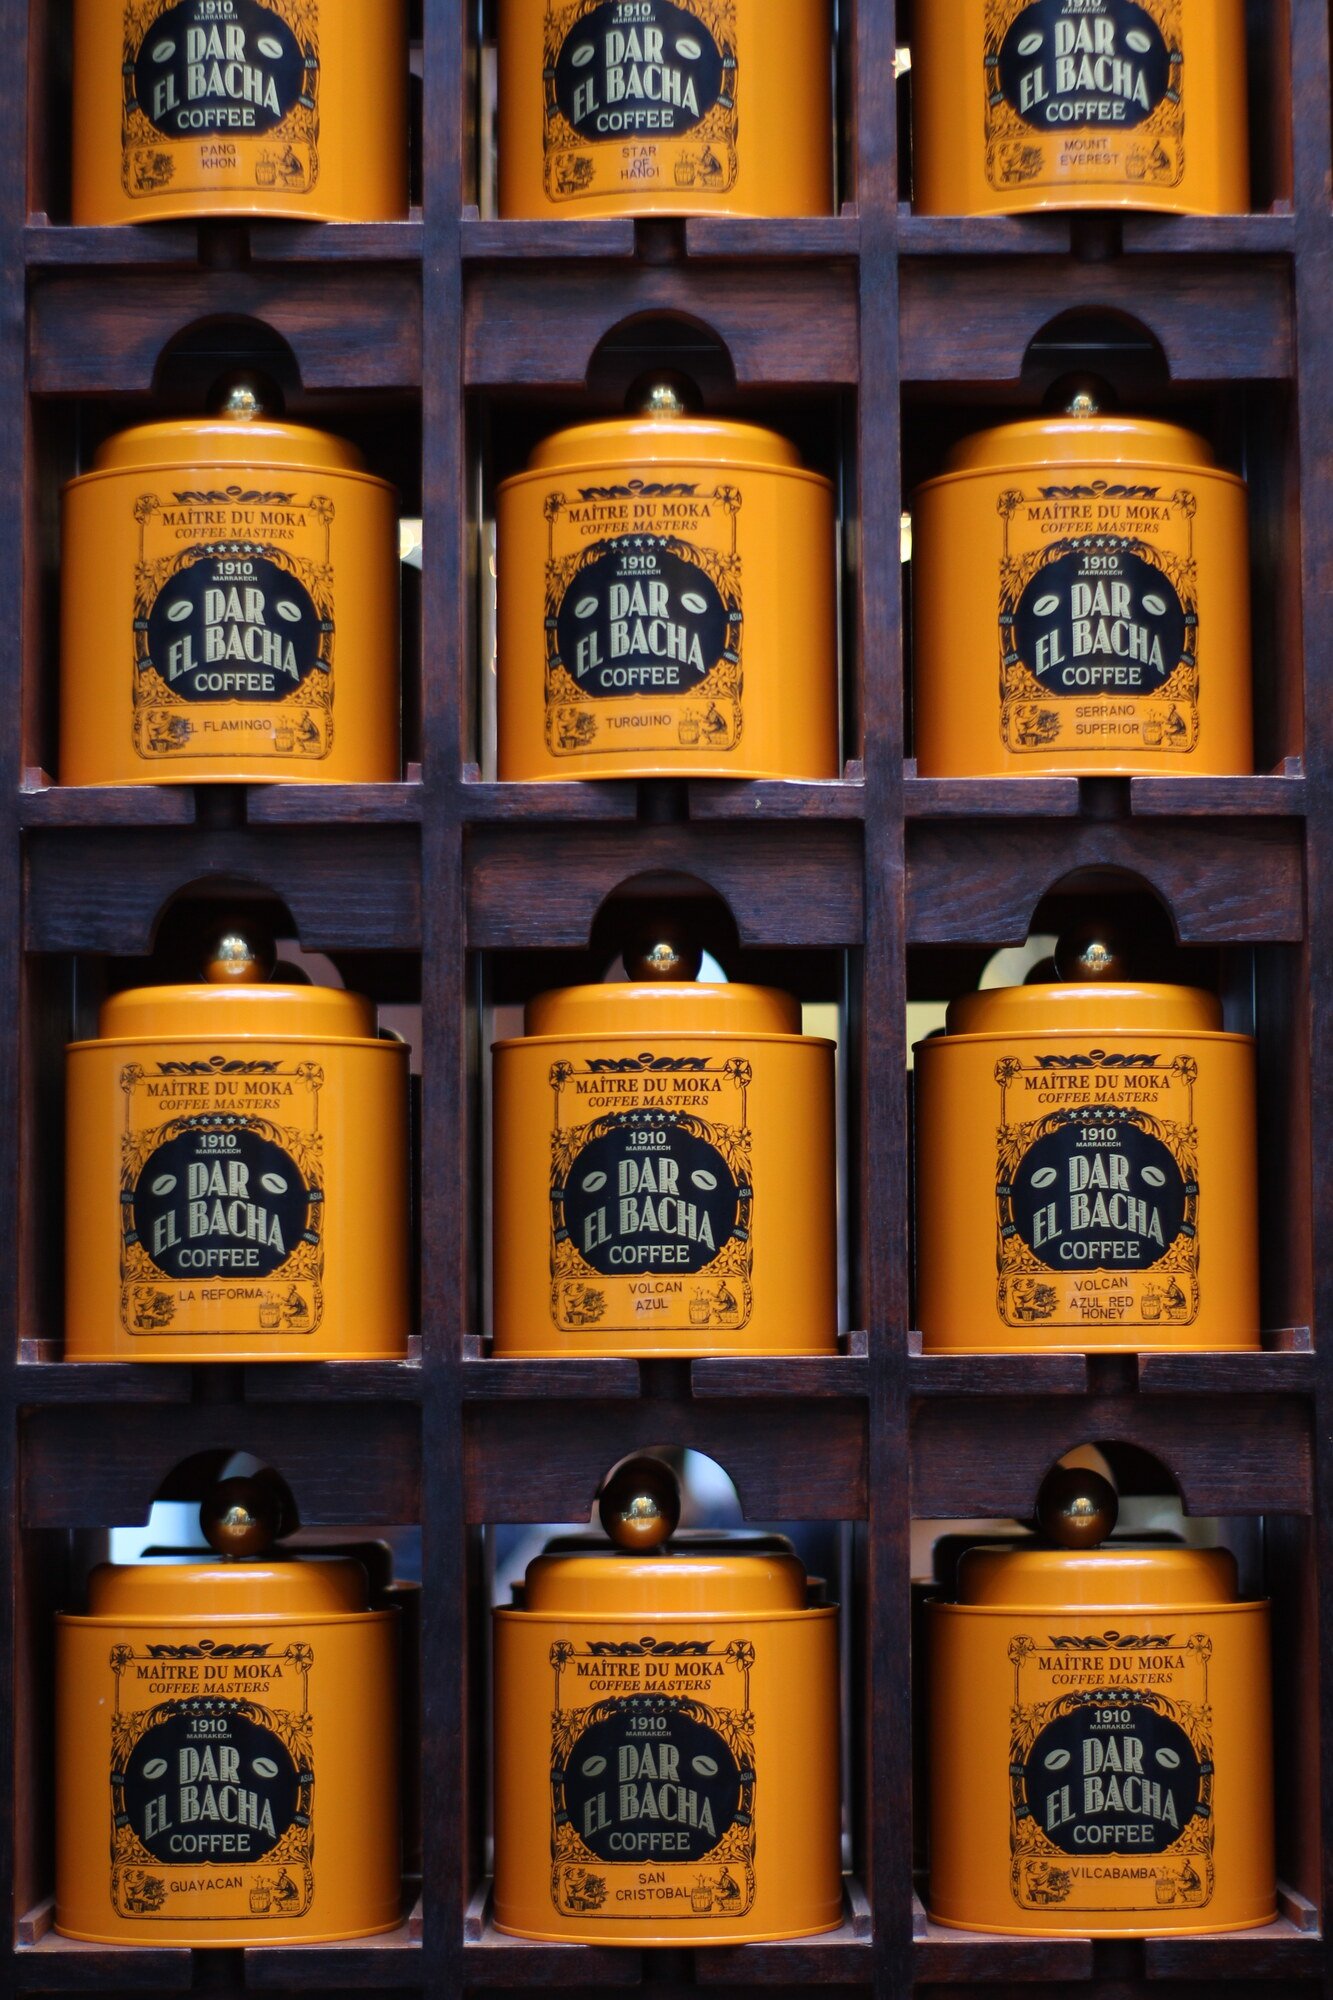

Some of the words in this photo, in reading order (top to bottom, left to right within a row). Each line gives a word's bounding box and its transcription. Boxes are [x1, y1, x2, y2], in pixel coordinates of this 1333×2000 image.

[199, 1, 233, 13] 1910
[616, 4, 651, 17] 1910
[187, 25, 246, 64] DAR
[1055, 17, 1115, 57] DAR
[606, 27, 664, 67] DAR
[153, 74, 180, 121] EL
[188, 62, 281, 118] BACHA
[1020, 66, 1049, 114] EL
[1056, 55, 1149, 111] BACHA
[573, 78, 599, 125] EL
[607, 64, 699, 118] BACHA
[177, 108, 256, 129] COFFEE
[1046, 102, 1126, 121] COFFEE
[597, 110, 674, 132] COFFEE
[201, 145, 236, 156] PANG
[622, 147, 657, 158] STAR
[1065, 138, 1108, 150] MOUNT
[202, 157, 236, 169] KHON
[633, 159, 649, 169] OF
[1061, 153, 1120, 166] EVEREST
[621, 168, 660, 180] HANOI
[163, 509, 226, 526] MAÎTRE
[232, 510, 255, 524] DU
[260, 513, 306, 527] MOKA
[569, 504, 628, 522] MAÎTRE
[633, 504, 657, 517] DU
[662, 504, 710, 517] MOKA
[1028, 503, 1092, 521] MAÎTRE
[1097, 505, 1122, 518] DU
[1126, 506, 1170, 520] MOKA
[175, 527, 226, 539] COFFEE
[230, 528, 294, 539] MASTERS
[580, 521, 629, 535] COFFEE
[632, 521, 697, 531] MASTERS
[1041, 522, 1092, 533] COFFEE
[1097, 522, 1159, 533] MASTERS
[217, 562, 253, 575] 1910
[620, 556, 656, 569] 1910
[1082, 556, 1118, 569] 1910
[205, 587, 266, 626] DAR
[610, 581, 669, 620] DAR
[1071, 581, 1132, 620] DAR
[169, 635, 198, 682] EL
[206, 624, 299, 681] BACHA
[577, 631, 603, 678] EL
[610, 619, 705, 673] BACHA
[1035, 629, 1064, 676] EL
[1072, 619, 1165, 675] BACHA
[195, 673, 275, 691] COFFEE
[600, 666, 680, 687] COFFEE
[1062, 666, 1142, 685] COFFEE
[1075, 705, 1135, 718] SERRANO
[204, 719, 272, 732] FLAMINGO
[606, 715, 671, 729] TURQUINO
[1076, 724, 1139, 735] SUPERIOR
[147, 1079, 209, 1097] MAÎTRE
[215, 1082, 239, 1095] DU
[244, 1081, 293, 1095] MOKA
[576, 1076, 638, 1094] MAÎTRE
[644, 1079, 668, 1092] DU
[673, 1078, 721, 1092] MOKA
[1025, 1073, 1090, 1090] MAÎTRE
[1096, 1076, 1119, 1088] DU
[1124, 1075, 1170, 1089] MOKA
[159, 1099, 210, 1111] COFFEE
[214, 1099, 280, 1110] MASTERS
[588, 1096, 639, 1108] COFFEE
[642, 1095, 709, 1107] MASTERS
[1038, 1092, 1090, 1104] COFFEE
[1094, 1092, 1159, 1103] MASTERS
[200, 1134, 236, 1148] 1910
[630, 1131, 666, 1145] 1910
[1080, 1128, 1116, 1141] 1910
[188, 1160, 250, 1199] DAR
[619, 1157, 679, 1197] DAR
[1069, 1153, 1130, 1192] DAR
[154, 1211, 182, 1256] EL
[189, 1199, 286, 1255] BACHA
[584, 1207, 612, 1253] EL
[620, 1196, 716, 1251] BACHA
[1033, 1202, 1062, 1249] EL
[1070, 1192, 1164, 1247] BACHA
[178, 1249, 260, 1268] COFFEE
[609, 1245, 690, 1264] COFFEE
[1059, 1241, 1140, 1260] COFFEE
[628, 1282, 683, 1295] VOLCAN
[1074, 1277, 1128, 1292] VOLCAN
[179, 1290, 195, 1301] LA
[201, 1289, 263, 1301] REFORMA
[1070, 1297, 1103, 1309] AZUL
[1109, 1296, 1134, 1308] RED
[636, 1298, 668, 1311] AZUL
[1081, 1308, 1124, 1320] HONEY
[137, 1662, 199, 1680] MAÎTRE
[204, 1665, 229, 1679] DU
[234, 1664, 283, 1678] MOKA
[577, 1660, 640, 1677] MAÎTRE
[646, 1663, 670, 1676] DU
[675, 1662, 725, 1676] MOKA
[1039, 1654, 1103, 1671] MAÎTRE
[1110, 1657, 1133, 1670] DU
[1139, 1655, 1185, 1670] MOKA
[590, 1680, 641, 1691] COFFEE
[644, 1679, 711, 1690] MASTERS
[1052, 1673, 1104, 1685] COFFEE
[1108, 1673, 1173, 1684] MASTERS
[149, 1682, 200, 1694] COFFEE
[203, 1682, 270, 1693] MASTERS
[630, 1717, 666, 1730] 1910
[1095, 1710, 1131, 1723] 1910
[191, 1719, 227, 1733] 1910
[179, 1745, 240, 1784] DAR
[619, 1743, 680, 1782] DAR
[1083, 1736, 1144, 1776] DAR
[144, 1794, 172, 1840] EL
[180, 1784, 277, 1839] BACHA
[584, 1792, 612, 1838] EL
[620, 1782, 716, 1838] BACHA
[1047, 1785, 1076, 1832] EL
[1084, 1775, 1179, 1830] BACHA
[609, 1832, 690, 1851] COFFEE
[1073, 1825, 1154, 1843] COFFEE
[170, 1833, 250, 1853] COFFEE
[639, 1872, 665, 1885] SAN
[1071, 1866, 1157, 1879] VILCABAMBA
[170, 1877, 243, 1892] GUAYACAN
[616, 1887, 690, 1901] CRISTOBAL
